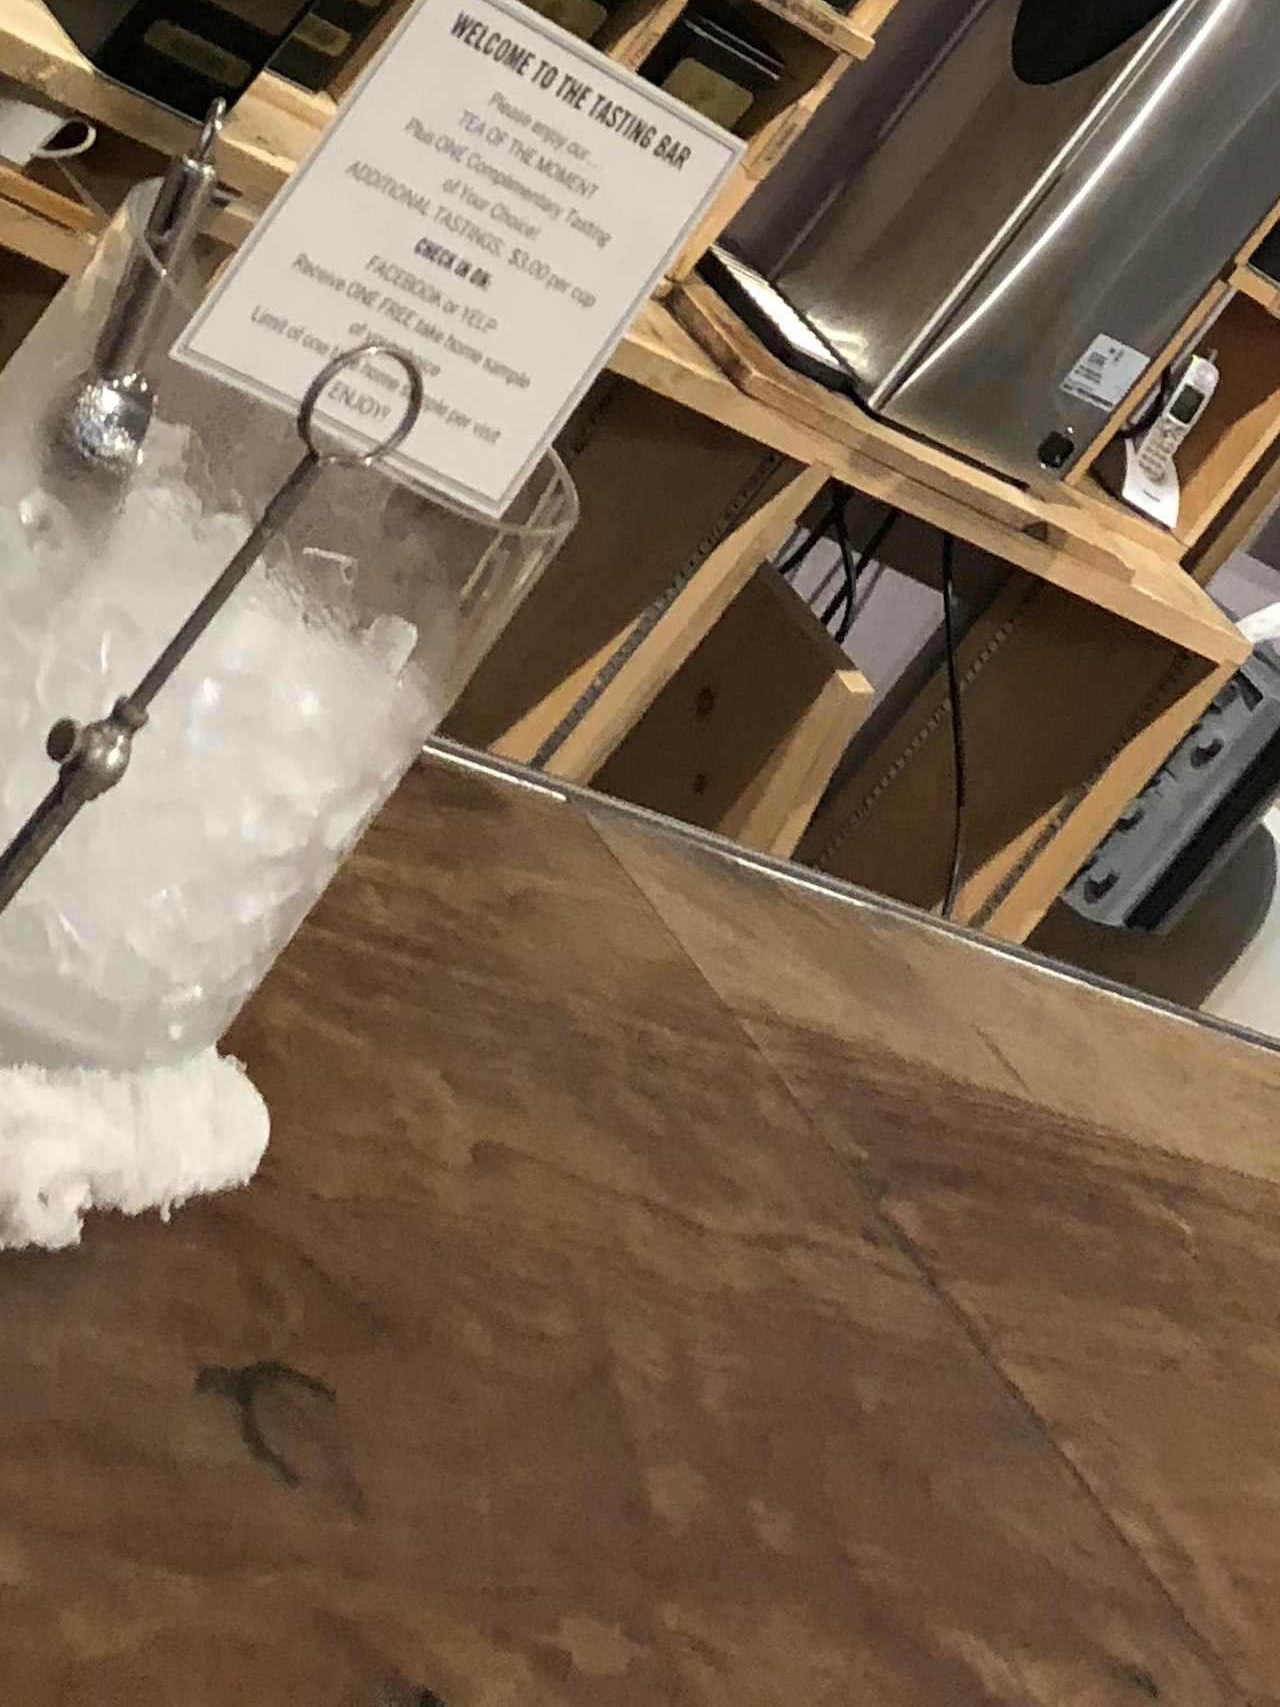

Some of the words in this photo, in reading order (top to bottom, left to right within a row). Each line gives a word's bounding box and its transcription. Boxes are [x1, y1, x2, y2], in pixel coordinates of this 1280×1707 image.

[445, 11, 538, 77] WELCOME
[526, 60, 562, 91] TO
[550, 74, 595, 110] THE
[583, 94, 661, 150] TASTING
[649, 134, 696, 172] BAR
[485, 90, 537, 128] Please
[526, 119, 569, 151] enjoy
[401, 117, 439, 146] Plus
[430, 133, 470, 164] ONE
[558, 208, 615, 249] Tasting
[453, 109, 490, 138] TEA
[482, 125, 512, 150] OF
[502, 137, 539, 166] THE
[531, 154, 600, 202] MOMENT
[344, 158, 435, 218] ADDITIONAL
[505, 247, 552, 281] $3.00
[542, 274, 571, 297] per
[567, 286, 598, 310] cup
[439, 176, 462, 196] of
[454, 184, 492, 214] Your
[485, 202, 543, 243] Choice!
[364, 254, 447, 309] FACEBOOK
[440, 298, 460, 316] or
[454, 304, 499, 338] YELP
[411, 235, 459, 271] CHECK
[452, 258, 475, 278] IN
[290, 251, 350, 293] Receive
[342, 280, 380, 308] ONE
[375, 296, 419, 328] FREE
[411, 317, 448, 345] take
[441, 333, 487, 366] home
[478, 354, 533, 393] sample
[346, 320, 368, 338] of
[247, 304, 291, 337] Limit
[282, 322, 306, 342] of
[299, 332, 332, 356] one
[358, 360, 403, 392] home
[441, 410, 471, 433] per
[467, 418, 503, 446] visit
